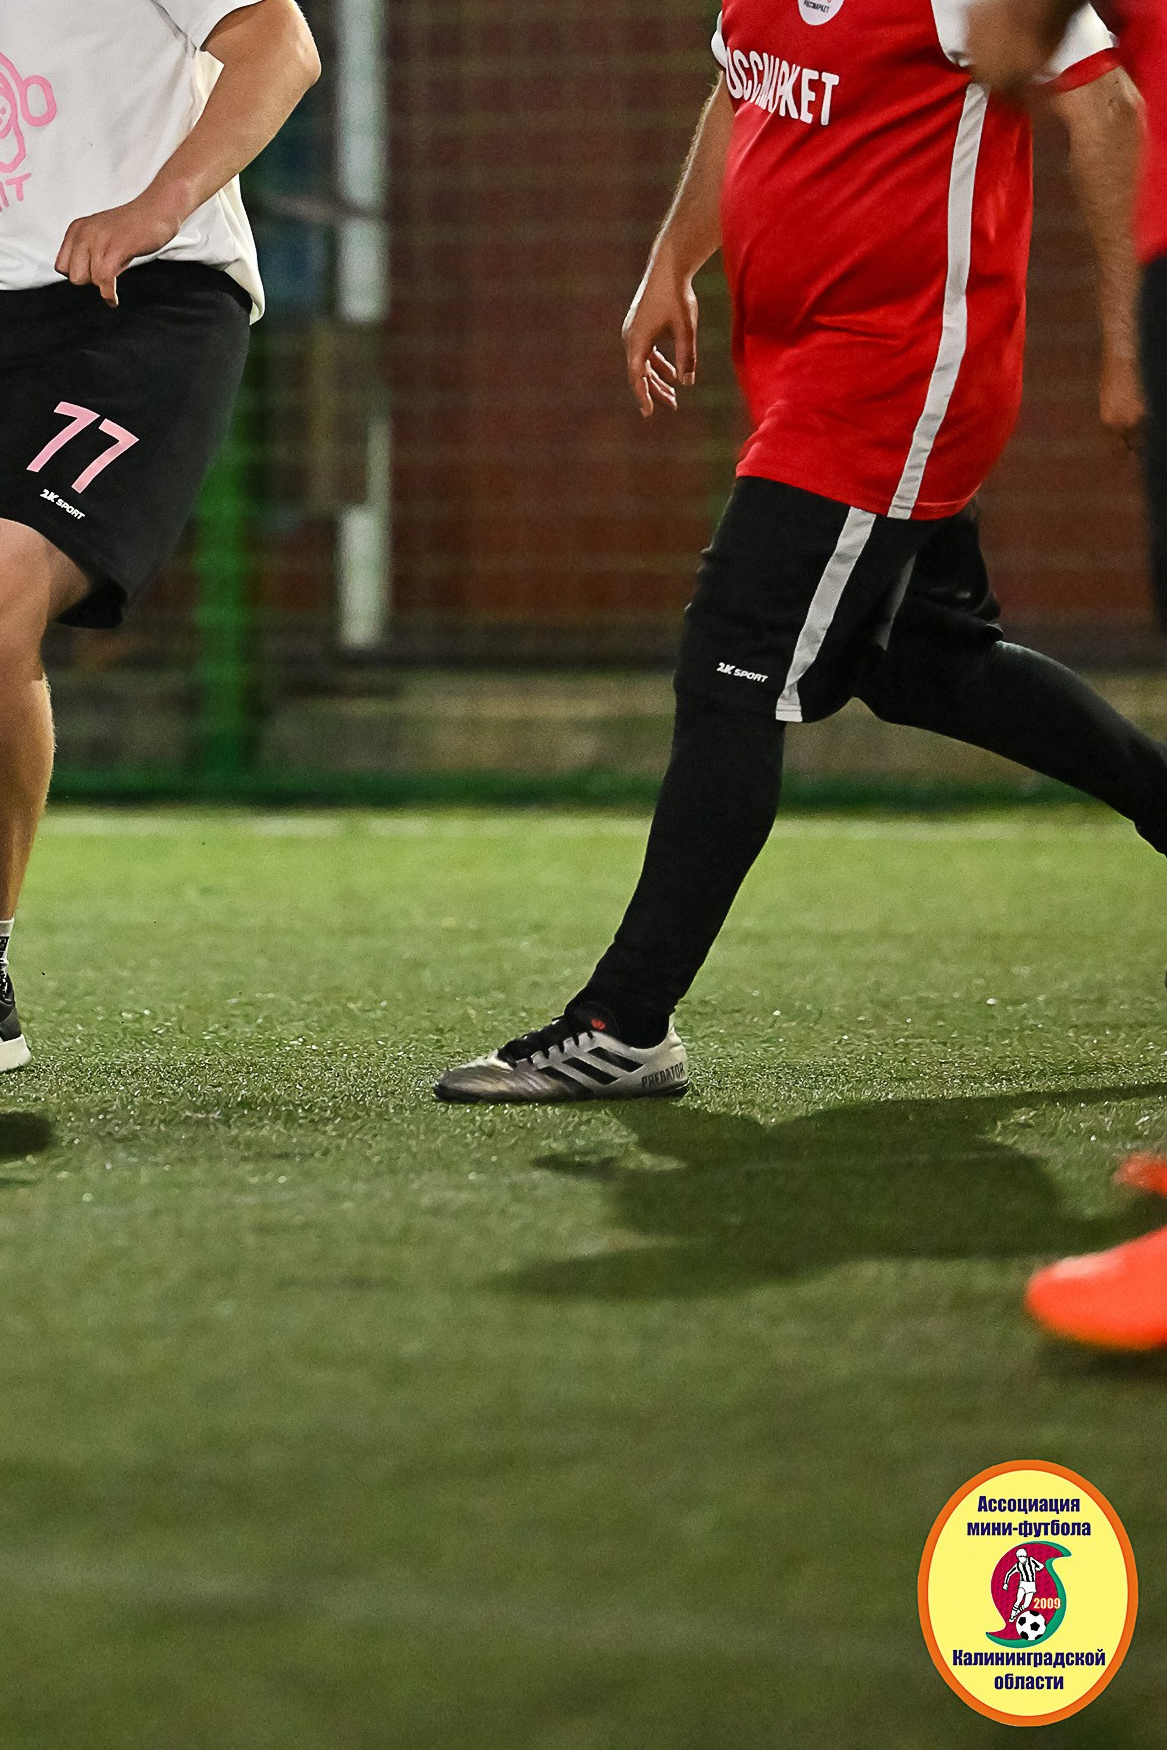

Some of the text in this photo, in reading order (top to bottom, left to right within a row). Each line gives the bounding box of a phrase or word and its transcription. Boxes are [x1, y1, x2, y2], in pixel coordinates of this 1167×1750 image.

[26, 400, 140, 494] 77
[39, 488, 86, 520] 2K SPORT
[716, 661, 769, 683] 2K SPORT
[641, 1061, 685, 1087] PREDATOR
